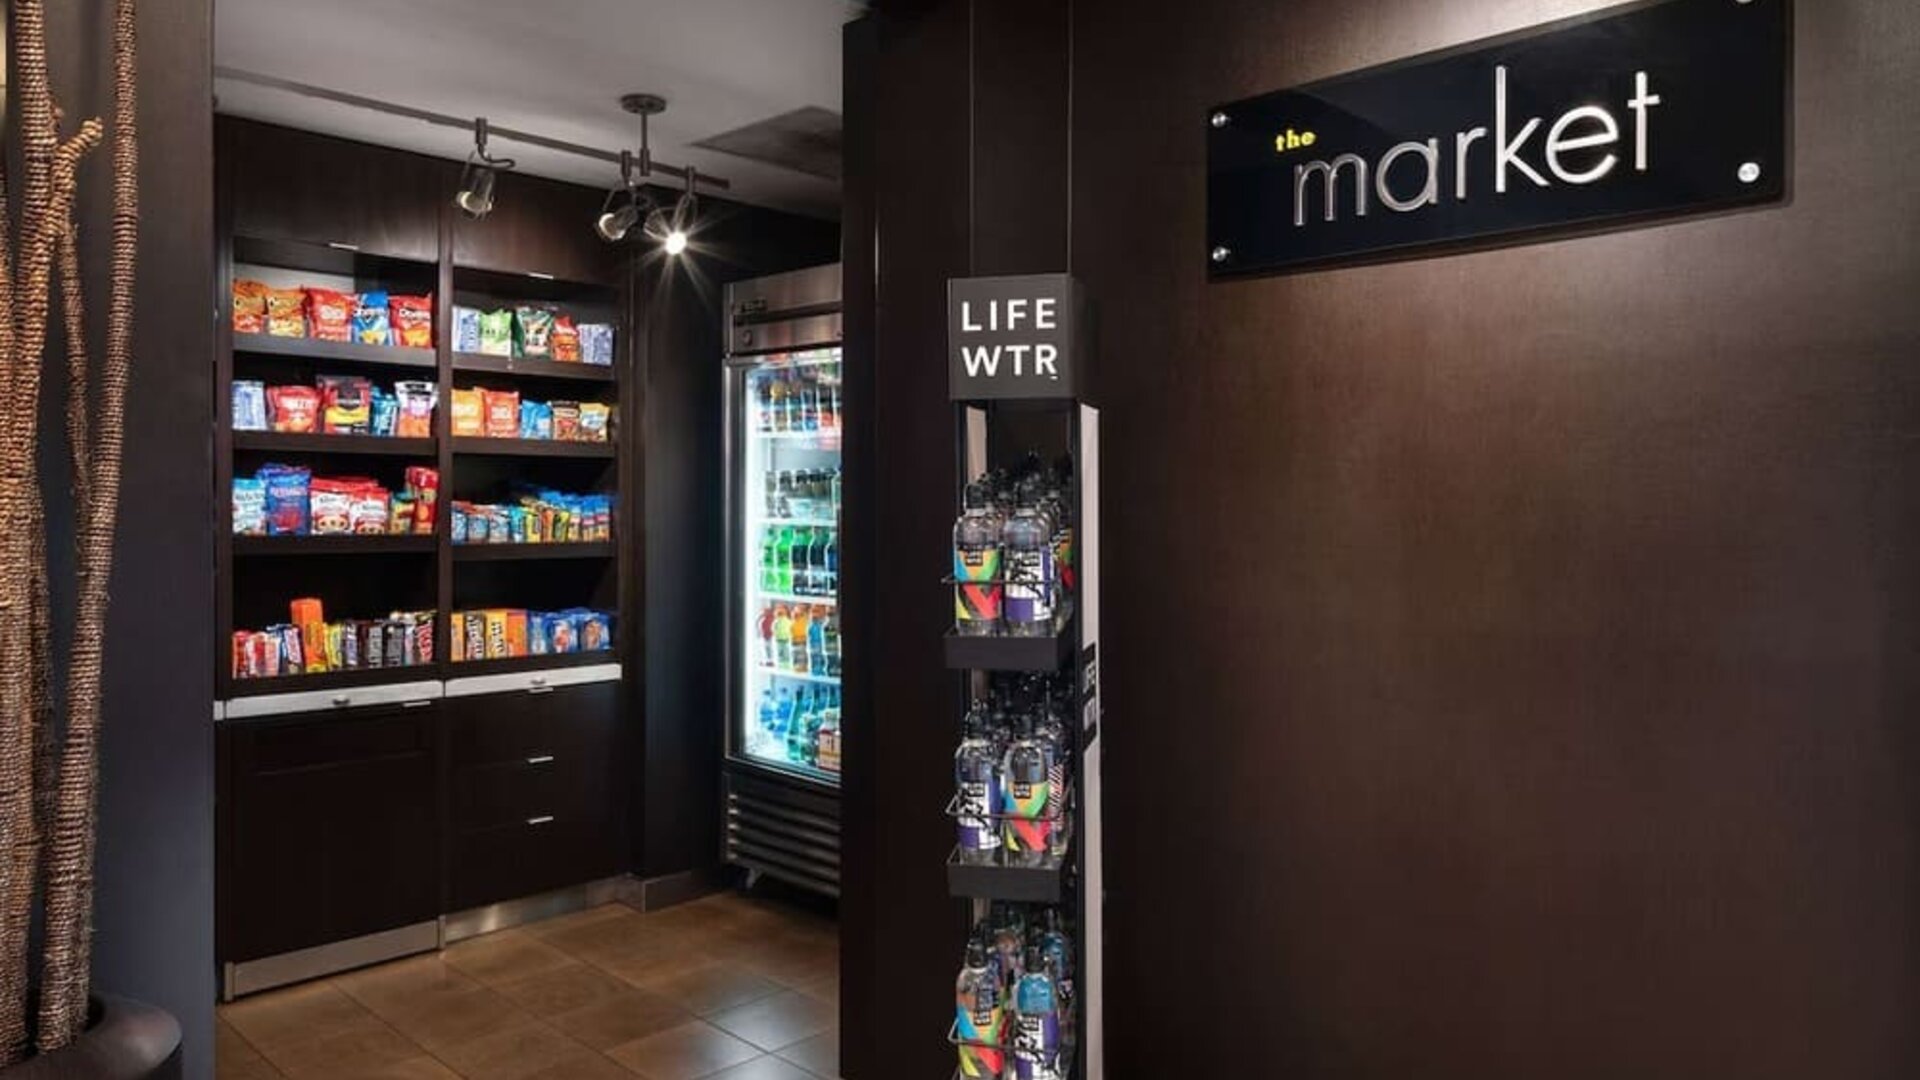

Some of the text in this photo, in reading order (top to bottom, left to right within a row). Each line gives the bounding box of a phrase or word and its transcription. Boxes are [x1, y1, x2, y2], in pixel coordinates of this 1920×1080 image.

[1275, 128, 1316, 152] the
[1293, 66, 1661, 227] market
[962, 298, 1057, 331] LIFE
[961, 344, 1058, 377] WTR
